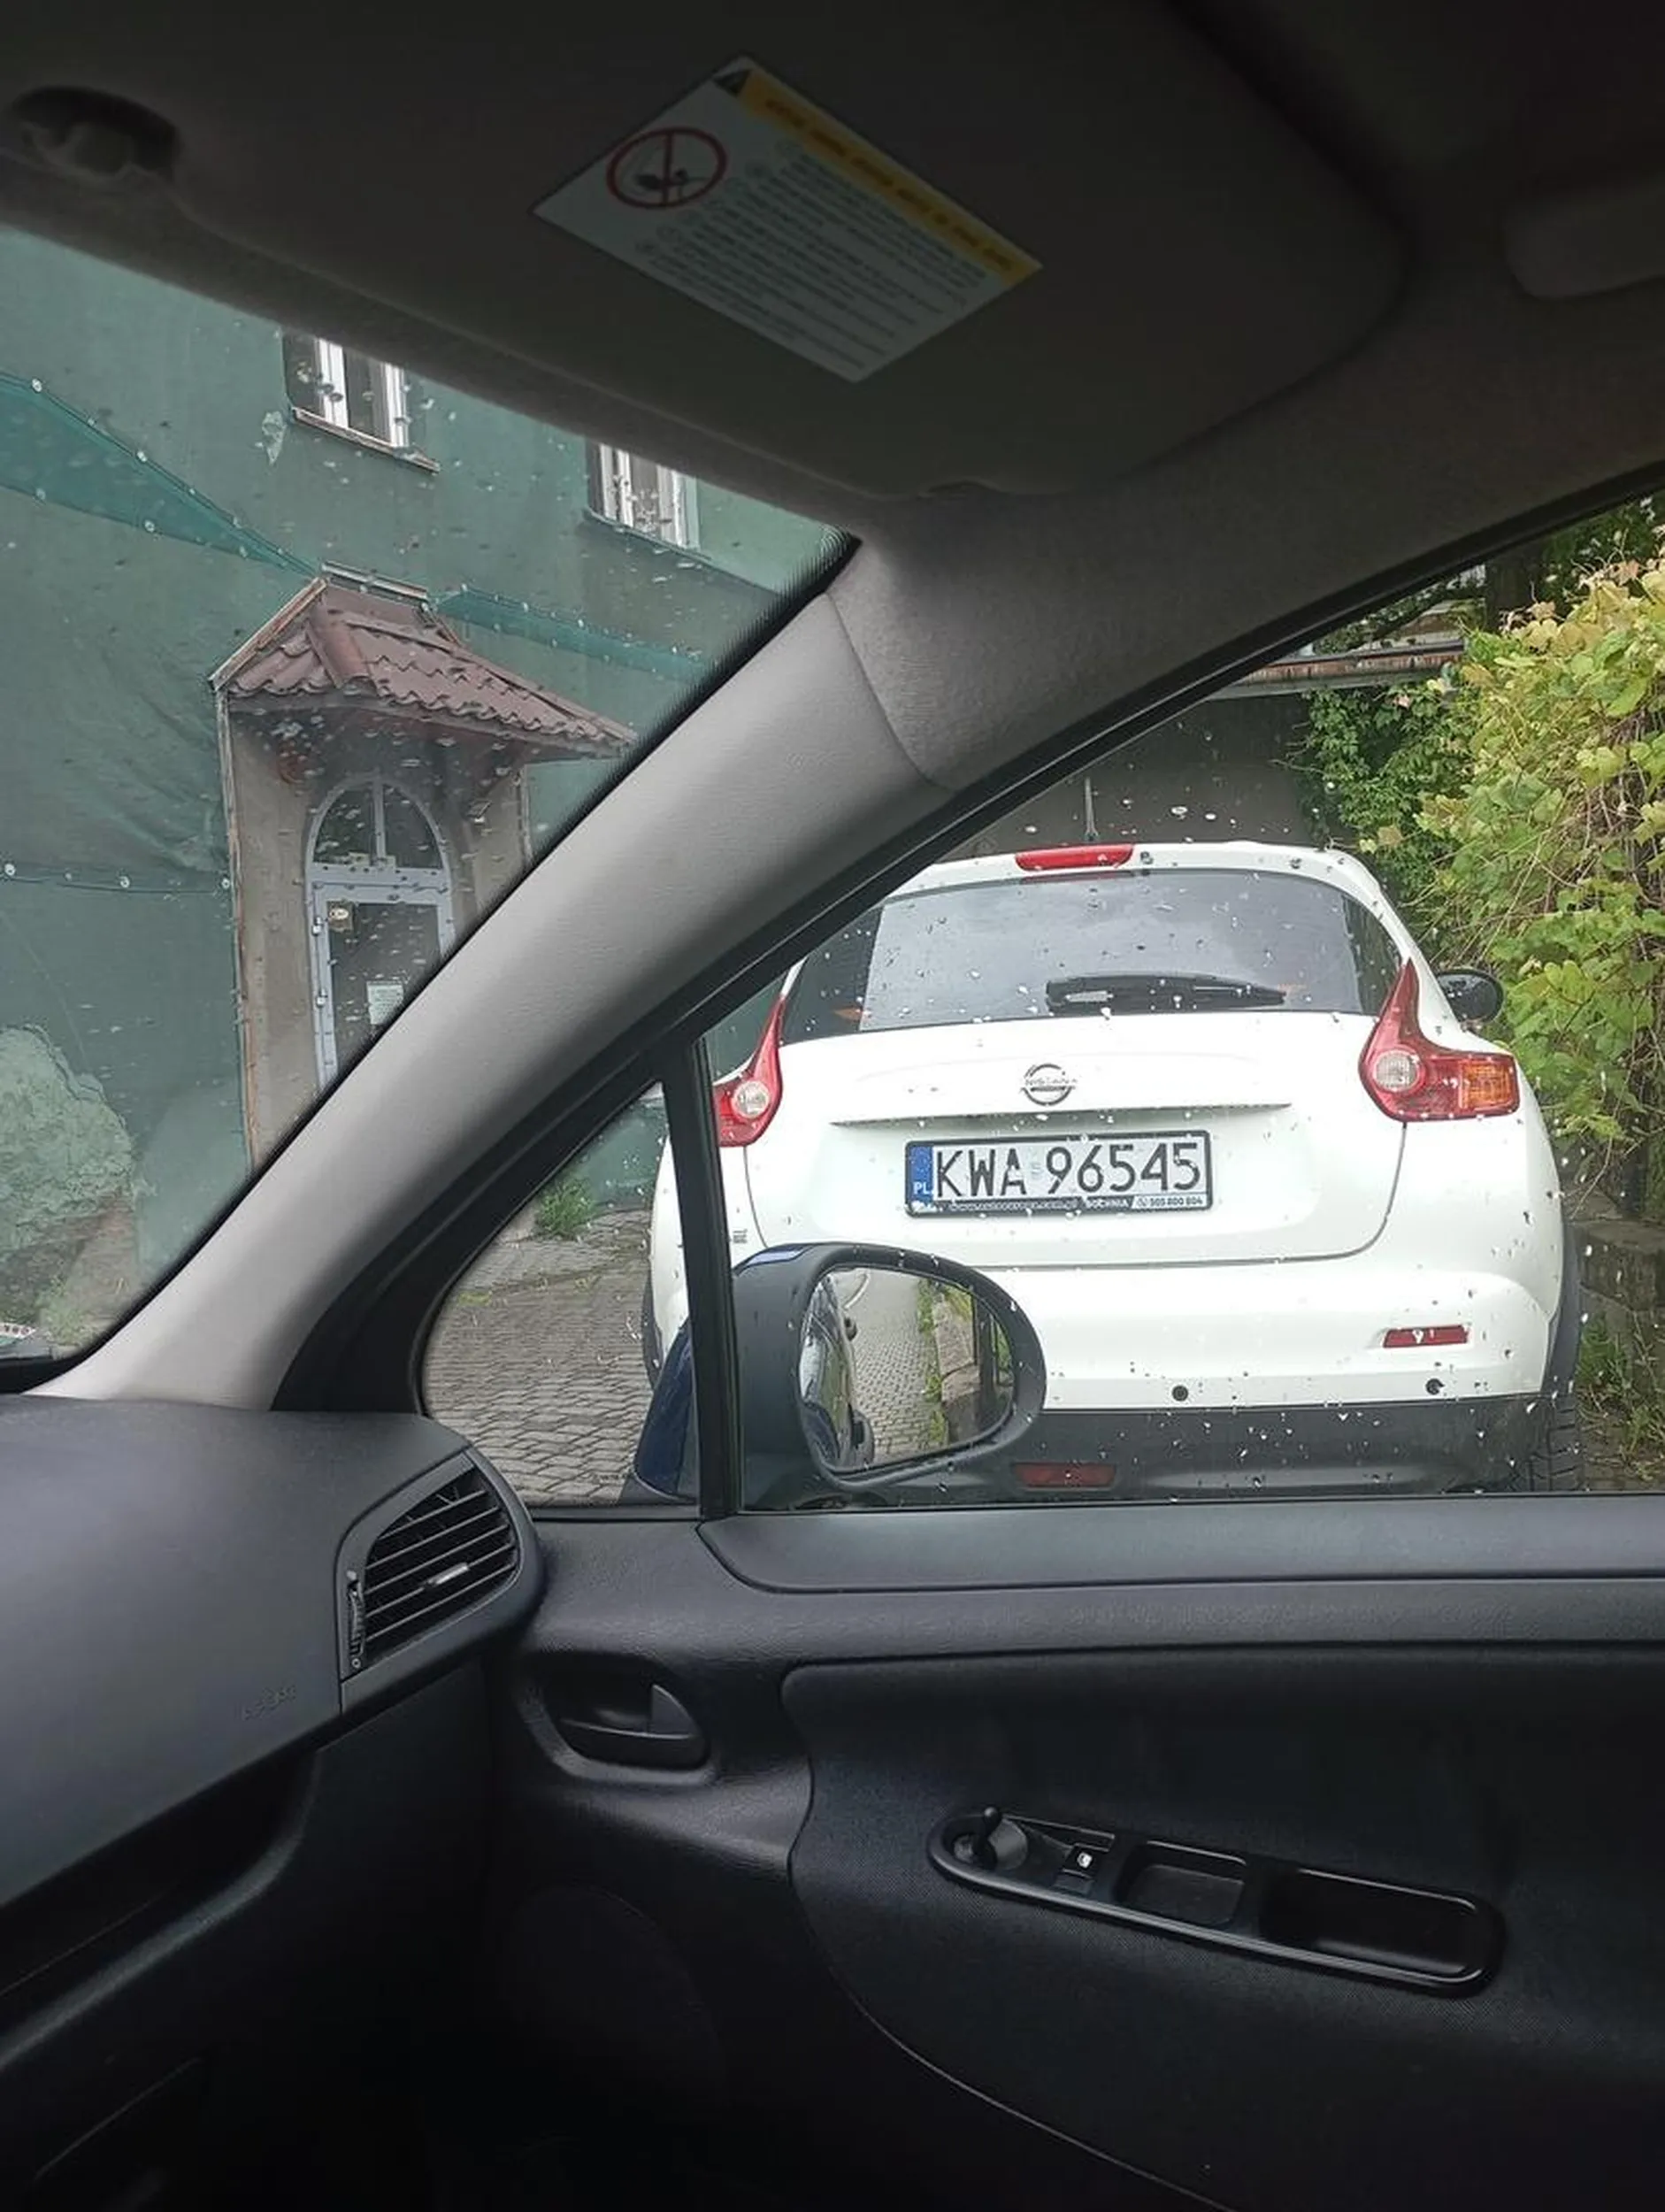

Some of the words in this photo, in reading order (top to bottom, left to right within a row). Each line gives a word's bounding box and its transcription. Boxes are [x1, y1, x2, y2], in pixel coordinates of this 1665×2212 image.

[936, 1148, 1027, 1196] KWA
[1045, 1141, 1201, 1194] 96545
[914, 1181, 930, 1194] PL
